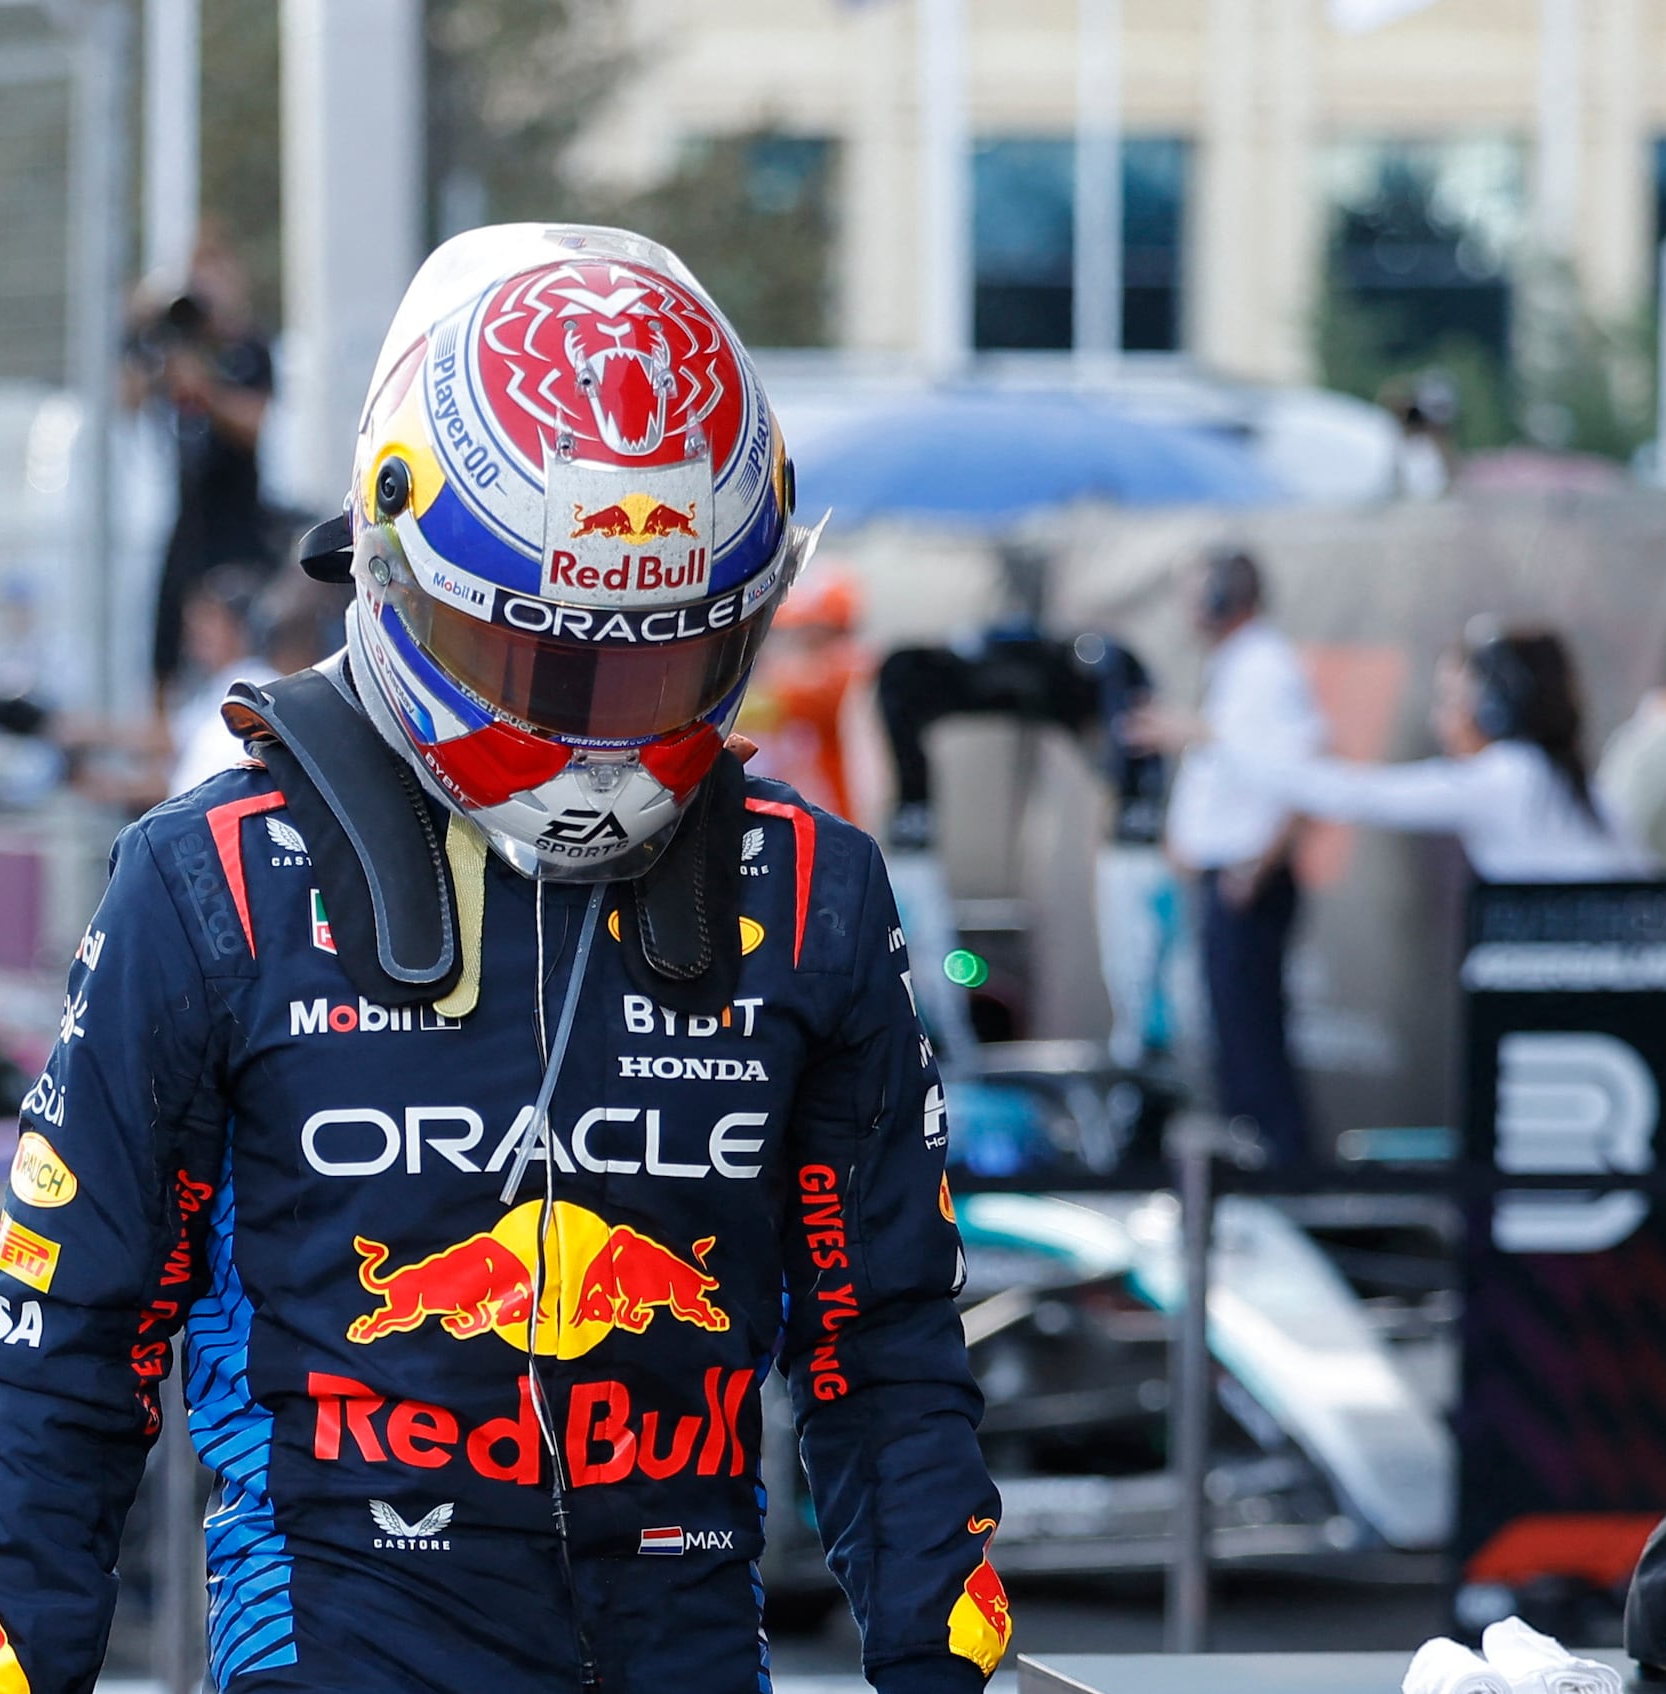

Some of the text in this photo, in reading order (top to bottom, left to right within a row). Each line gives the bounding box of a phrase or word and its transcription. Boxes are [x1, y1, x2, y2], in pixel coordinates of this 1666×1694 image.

[433, 571, 470, 600] Mobil
[549, 547, 706, 593] Red Bull
[504, 595, 737, 643] ORACLE
[424, 751, 470, 804] BYBIT
[541, 809, 630, 845] EA
[535, 839, 630, 858] SPORTS
[290, 997, 412, 1036] Mobil
[618, 1056, 770, 1081] HONDA
[301, 1105, 769, 1180] ORACLE
[1492, 1031, 1661, 1253] 3
[799, 1163, 849, 1269] GIVES
[307, 1368, 546, 1487] Red
[566, 1367, 754, 1488] Bull
[373, 1538, 451, 1551] CASTORE
[685, 1530, 734, 1550] MAX
